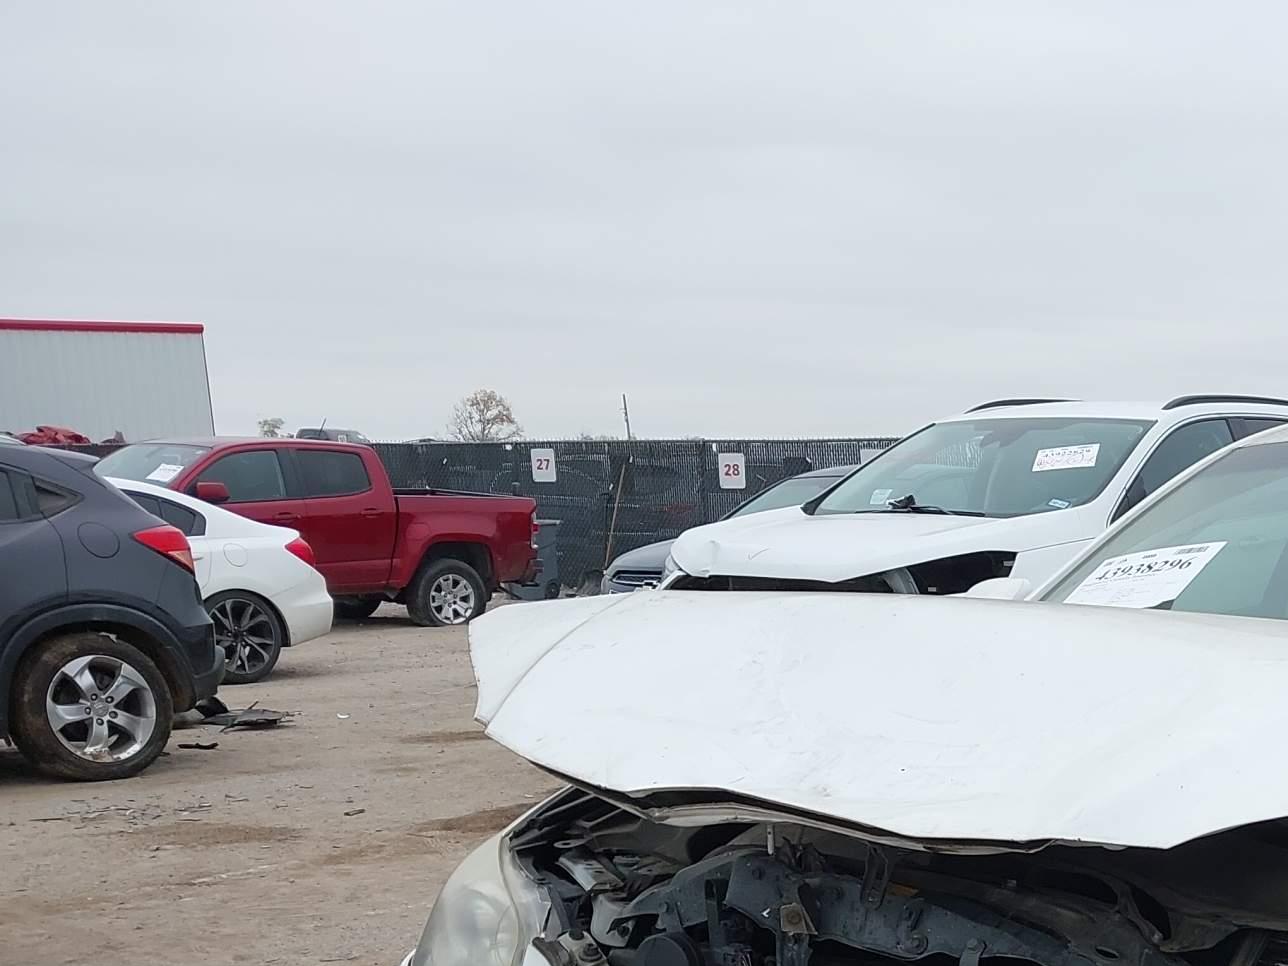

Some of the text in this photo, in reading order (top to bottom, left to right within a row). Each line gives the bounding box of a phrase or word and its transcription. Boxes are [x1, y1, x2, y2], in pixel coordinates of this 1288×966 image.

[536, 458, 551, 471] 27
[724, 463, 740, 477] 28
[1095, 556, 1195, 582] 43938296
